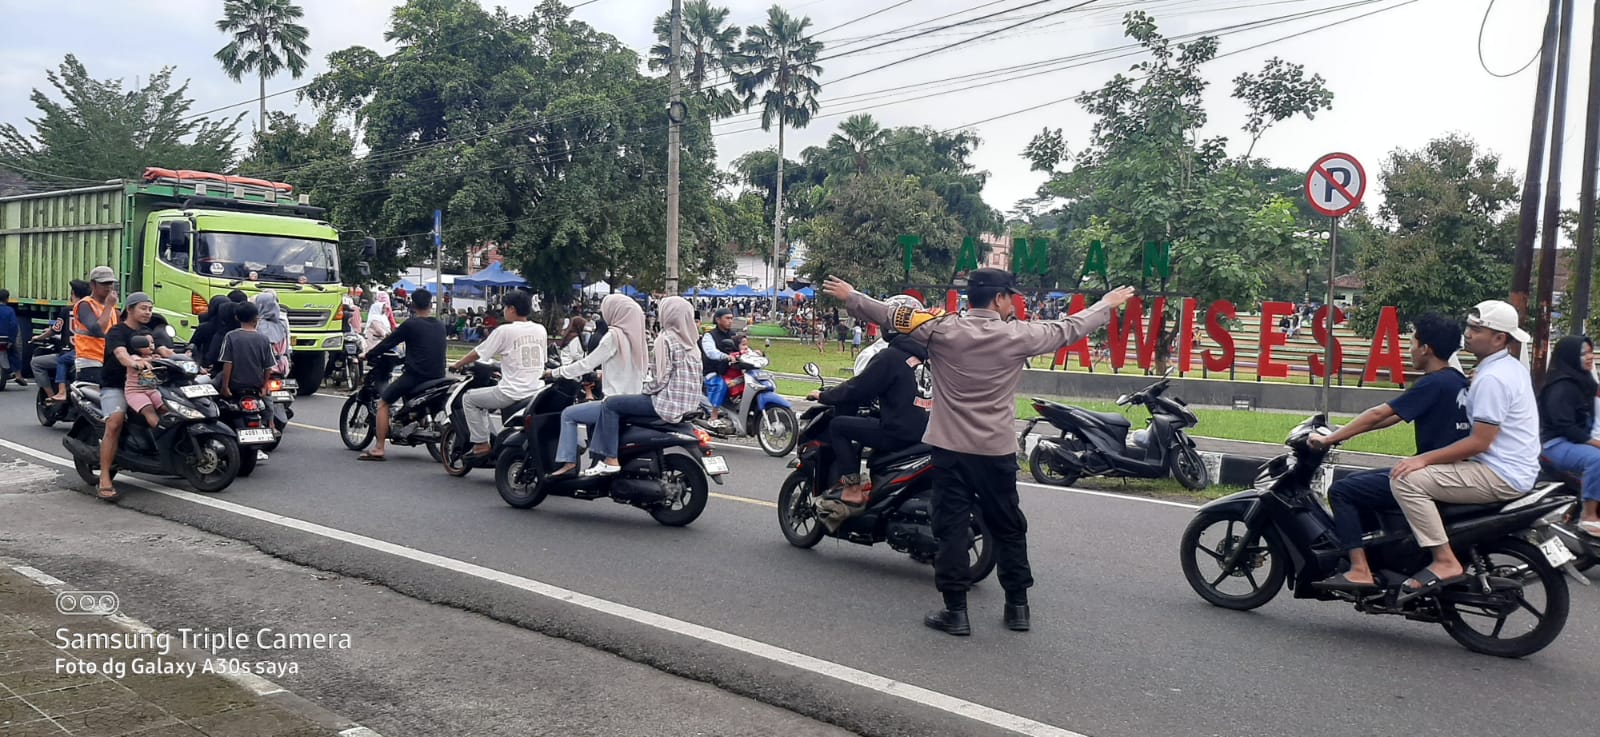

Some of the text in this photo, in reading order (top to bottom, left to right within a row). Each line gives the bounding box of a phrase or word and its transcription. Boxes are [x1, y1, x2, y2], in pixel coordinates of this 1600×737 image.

[1325, 167, 1351, 203] P
[898, 235, 1170, 279] TAMAN
[902, 287, 1406, 383] AWISESA
